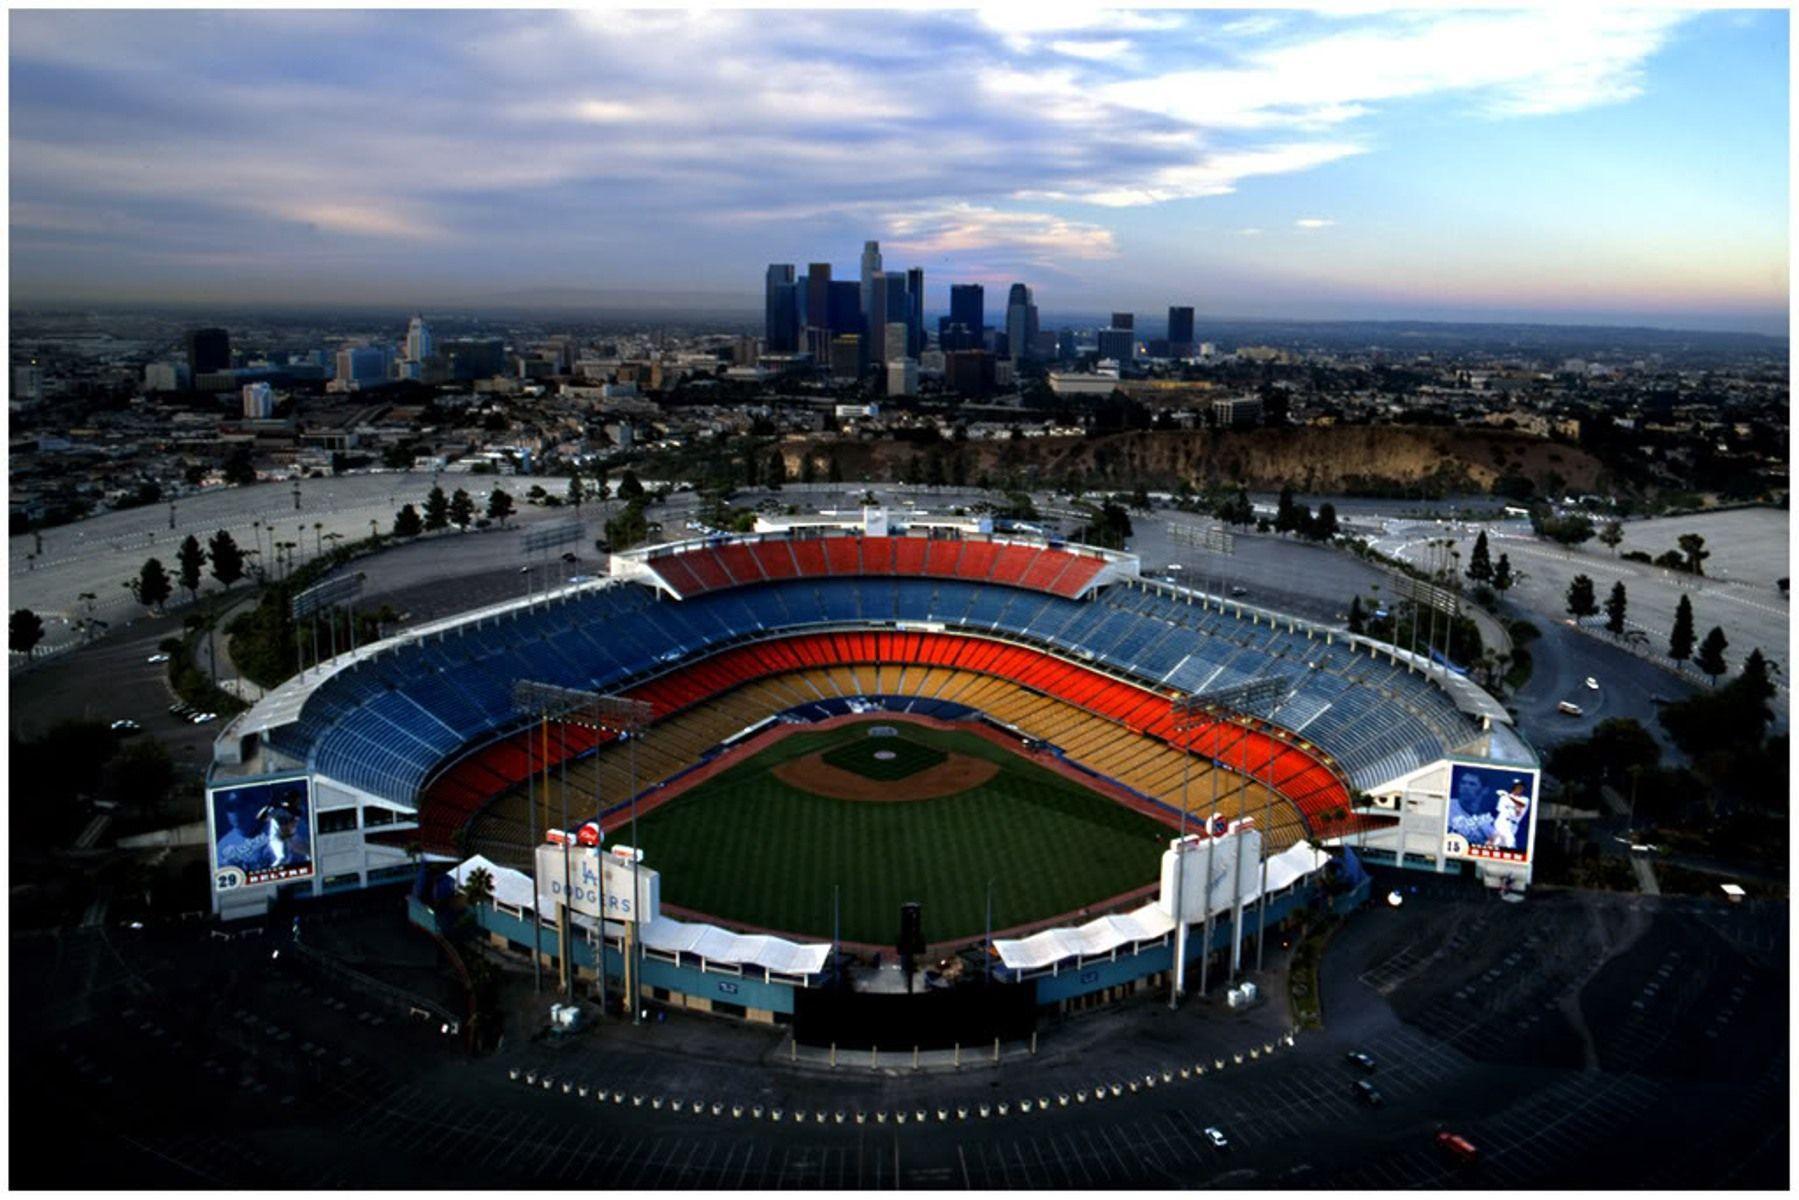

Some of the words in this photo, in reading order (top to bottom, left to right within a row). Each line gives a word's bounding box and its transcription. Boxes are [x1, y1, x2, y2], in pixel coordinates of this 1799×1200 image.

[1447, 841, 1460, 852] 15
[218, 874, 237, 888] 29
[552, 881, 631, 912] DODGRS
